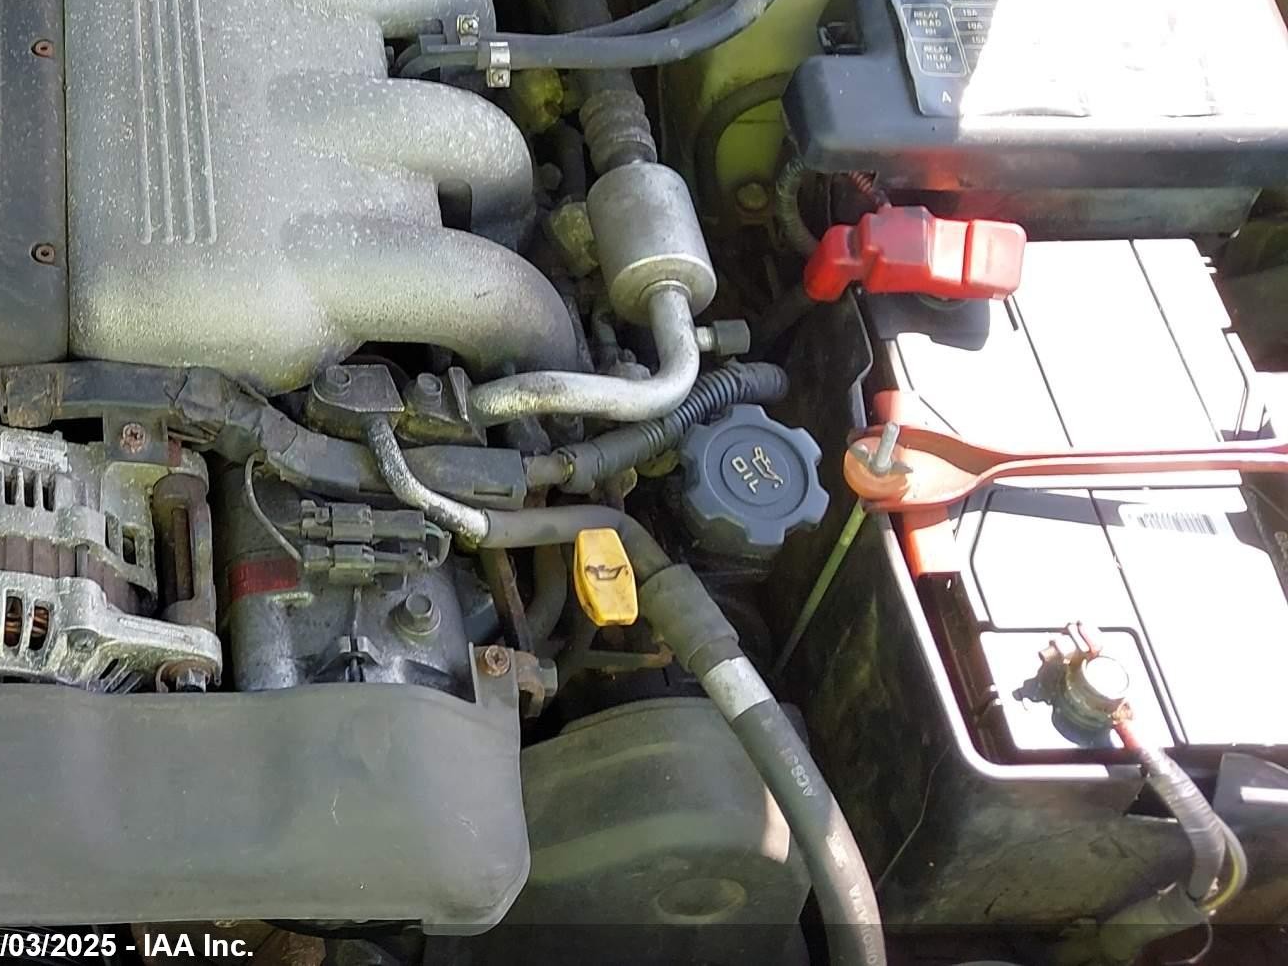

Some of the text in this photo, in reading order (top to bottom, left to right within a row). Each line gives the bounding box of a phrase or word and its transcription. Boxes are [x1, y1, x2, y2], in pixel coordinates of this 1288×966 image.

[914, 10, 938, 18] RELAY
[915, 19, 941, 27] HEAD
[923, 45, 948, 53] RELAY
[942, 91, 952, 103] A
[731, 456, 759, 494] OIL
